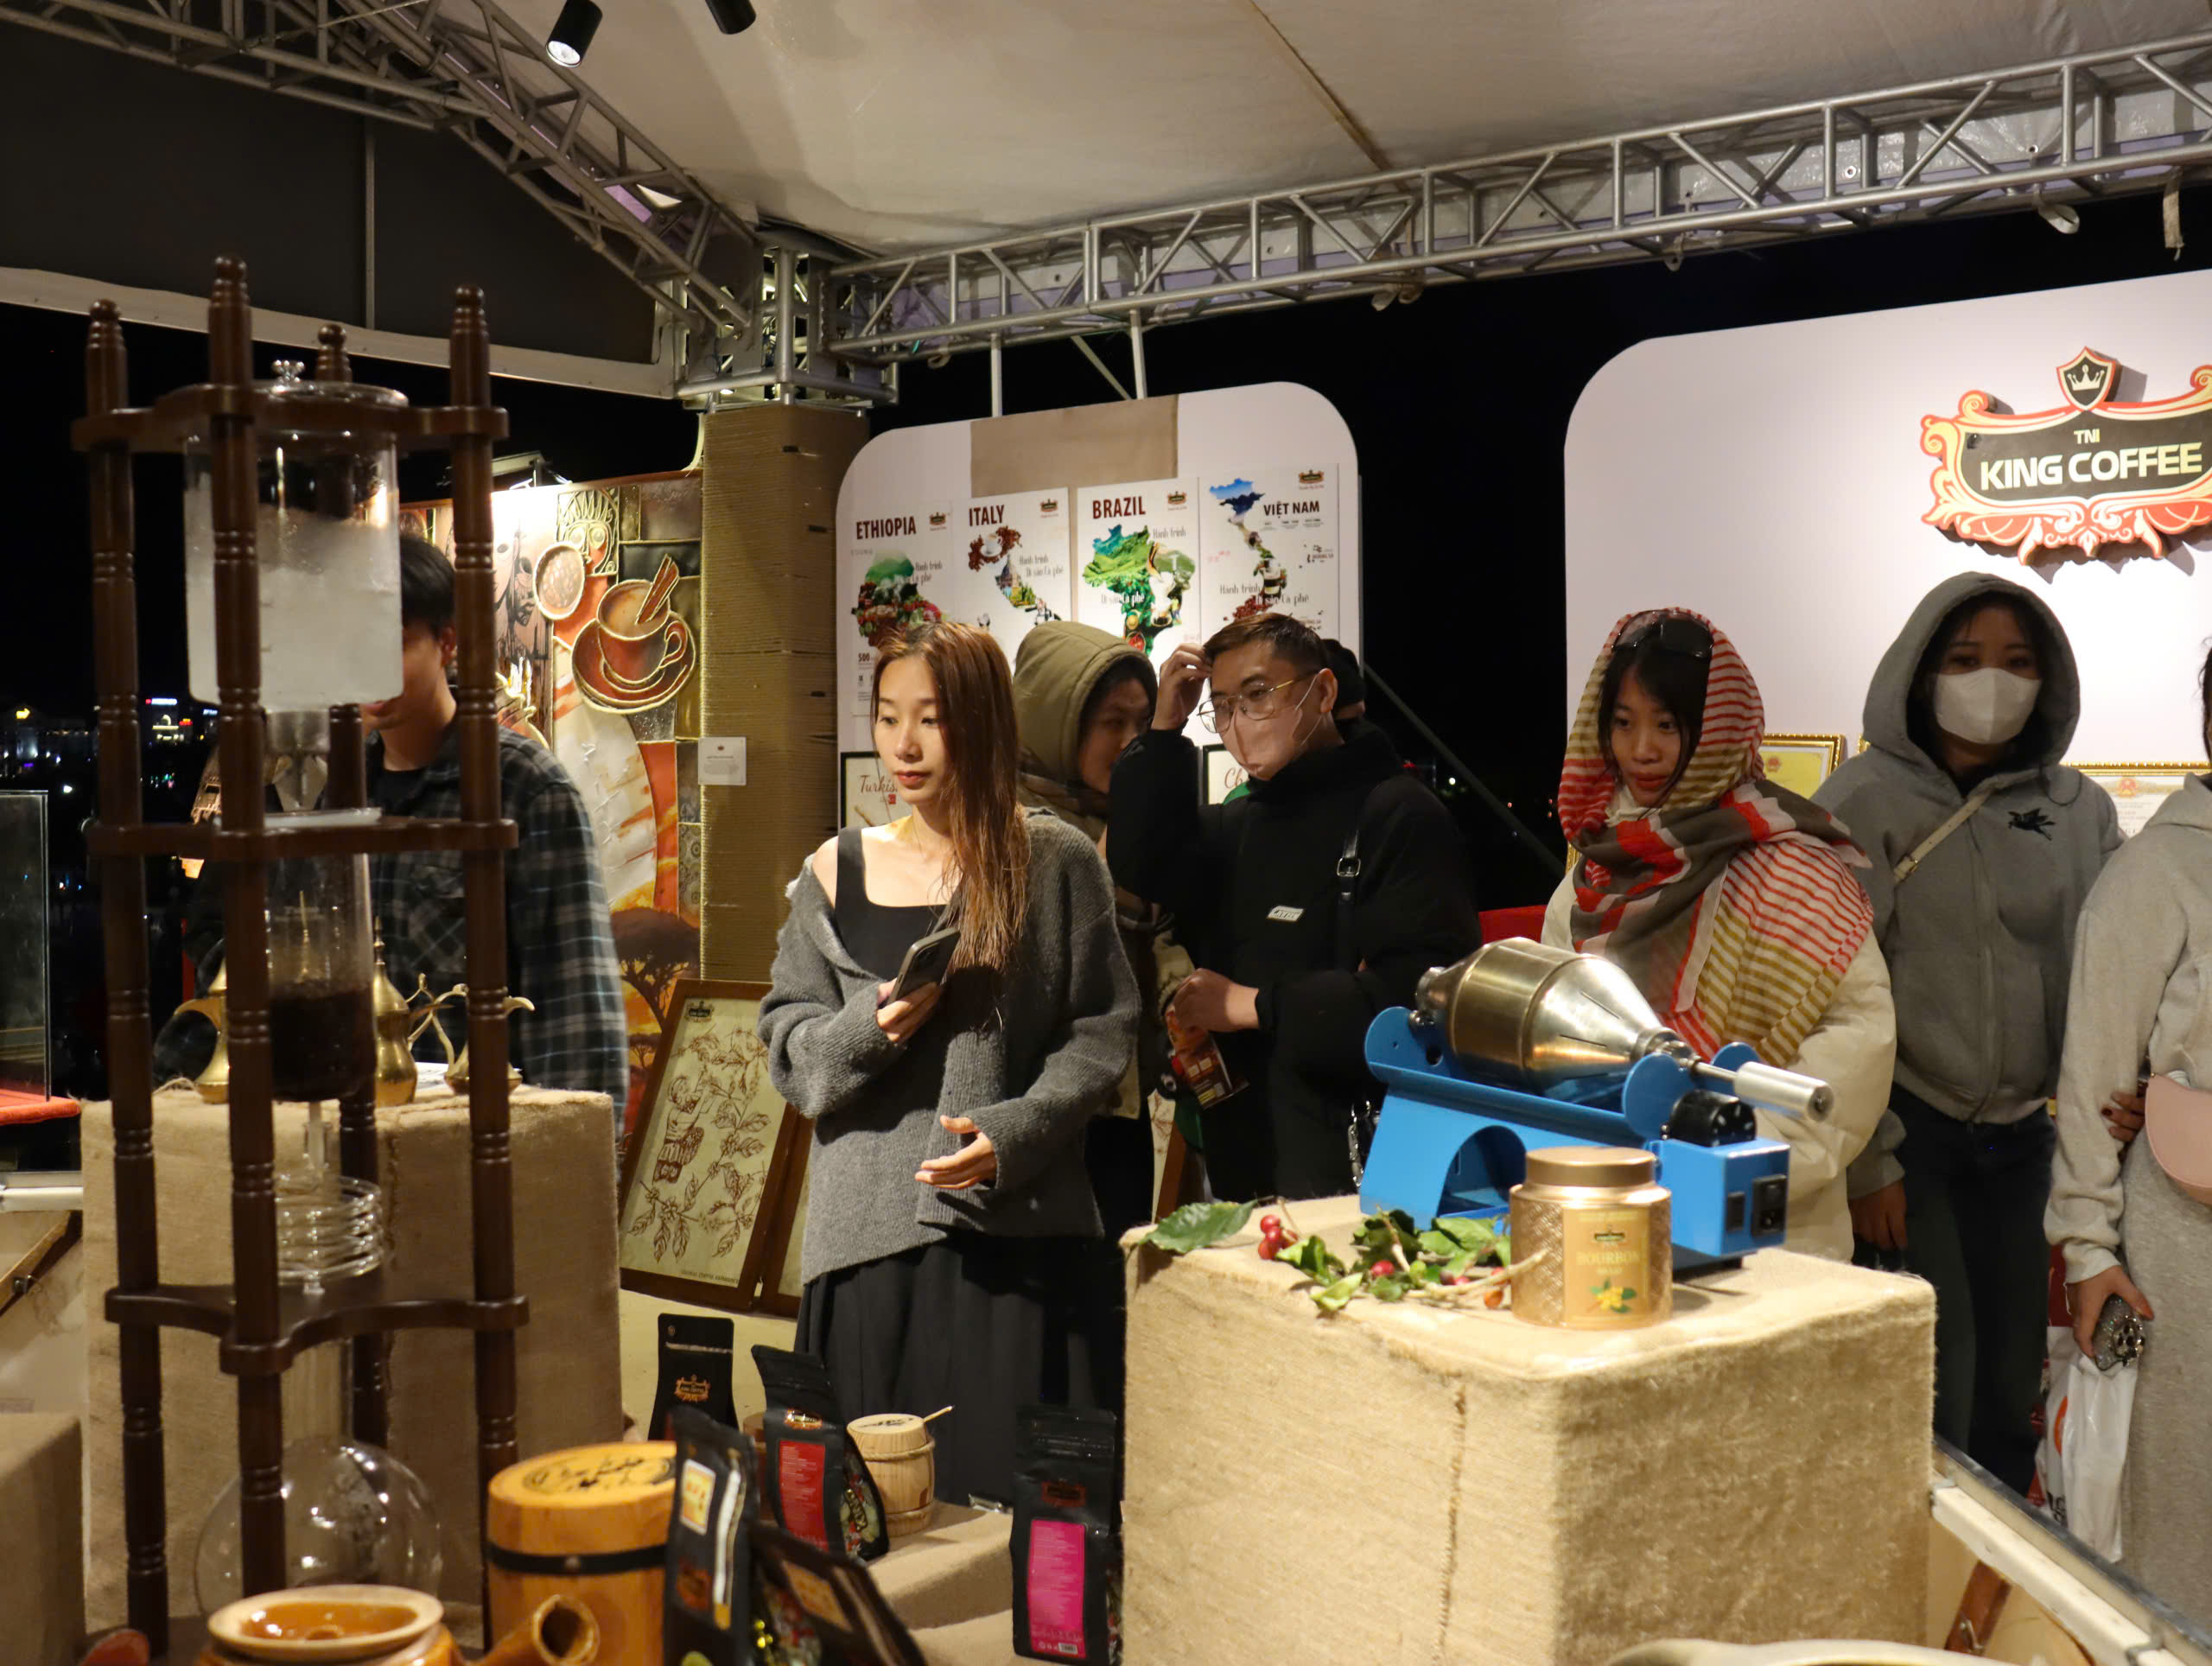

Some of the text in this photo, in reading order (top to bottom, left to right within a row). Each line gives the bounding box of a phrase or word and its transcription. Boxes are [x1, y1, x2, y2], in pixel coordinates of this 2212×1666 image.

[2074, 428, 2101, 444] TNI
[1980, 442, 2202, 491] KING COFFEE
[969, 504, 1005, 526] ITALY
[1092, 496, 1146, 519] BRAZIL
[1263, 500, 1320, 518] VIỆT NAM
[856, 516, 917, 540] ETHIOPIA
[858, 652, 870, 662] 500
[860, 774, 899, 793] Turkis
